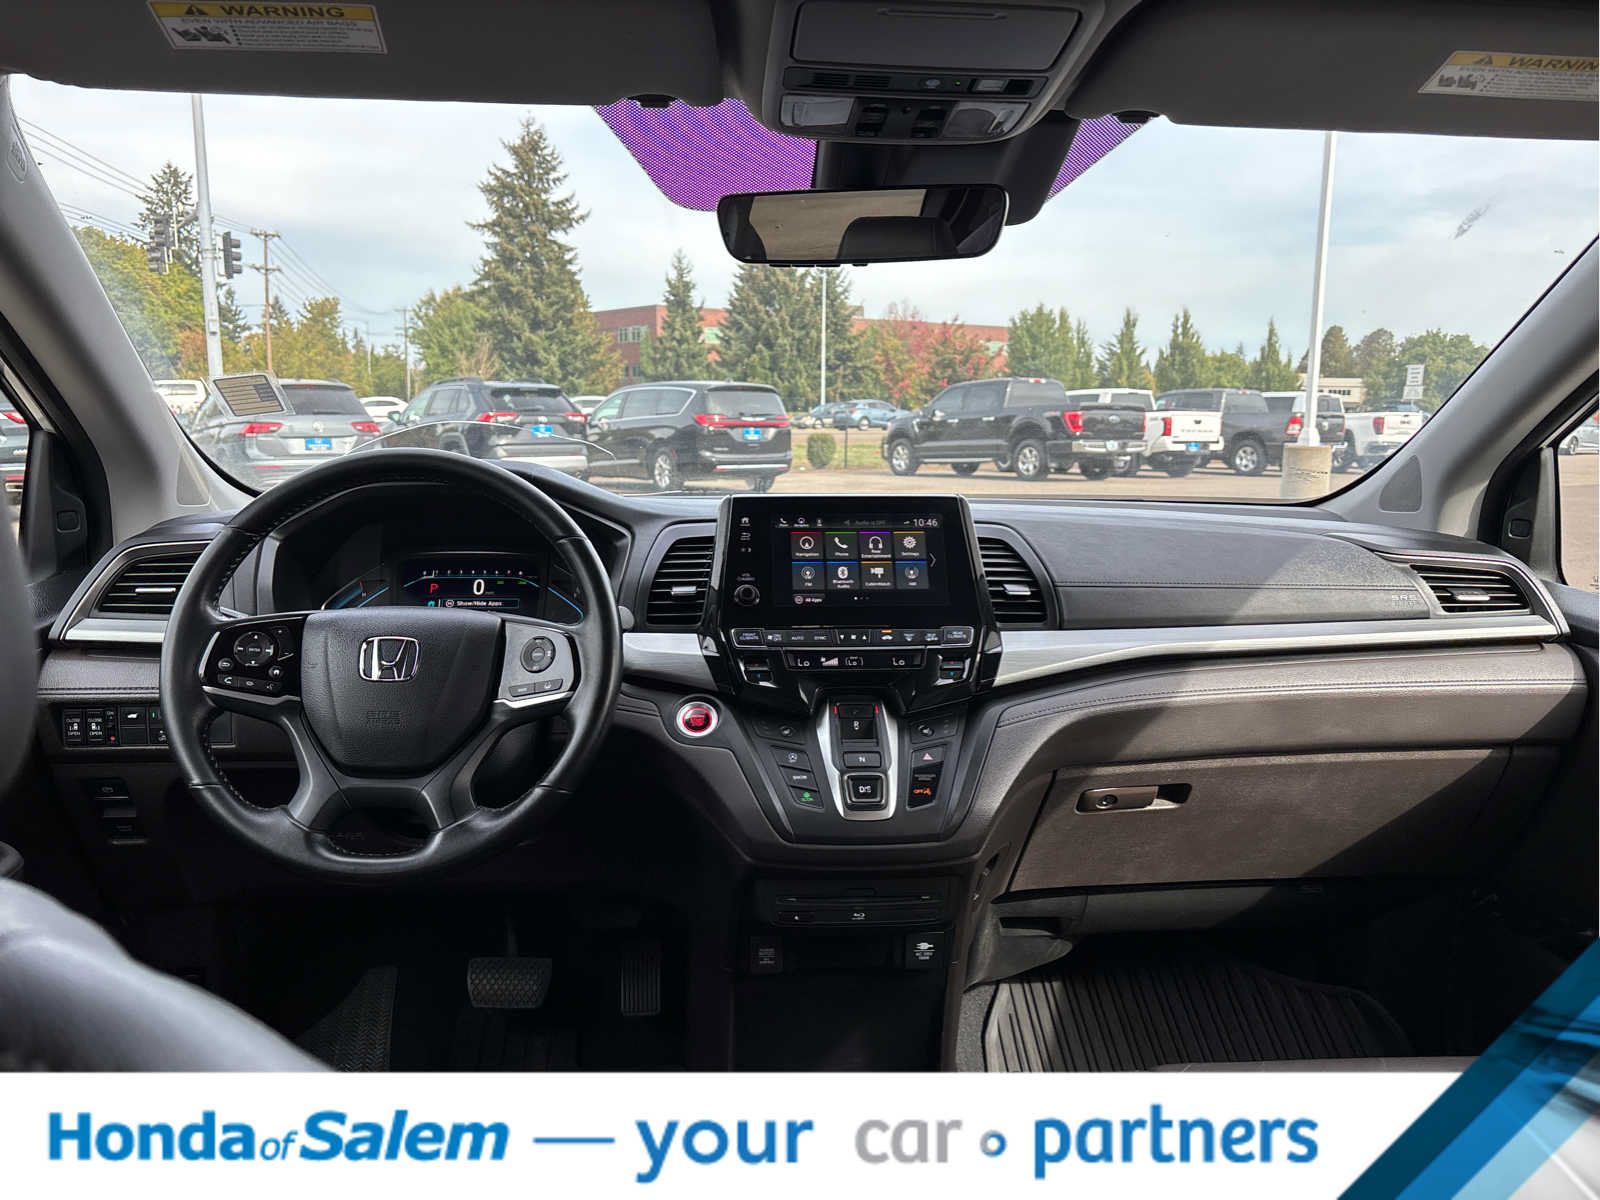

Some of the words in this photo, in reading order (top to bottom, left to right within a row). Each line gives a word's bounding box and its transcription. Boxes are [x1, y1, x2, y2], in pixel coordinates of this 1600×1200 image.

[219, 4, 345, 18] WARNING
[913, 518, 938, 527] 10:46
[430, 583, 439, 594] P
[473, 579, 486, 596] 0
[797, 658, 810, 667] Lo
[892, 657, 905, 666] Lo
